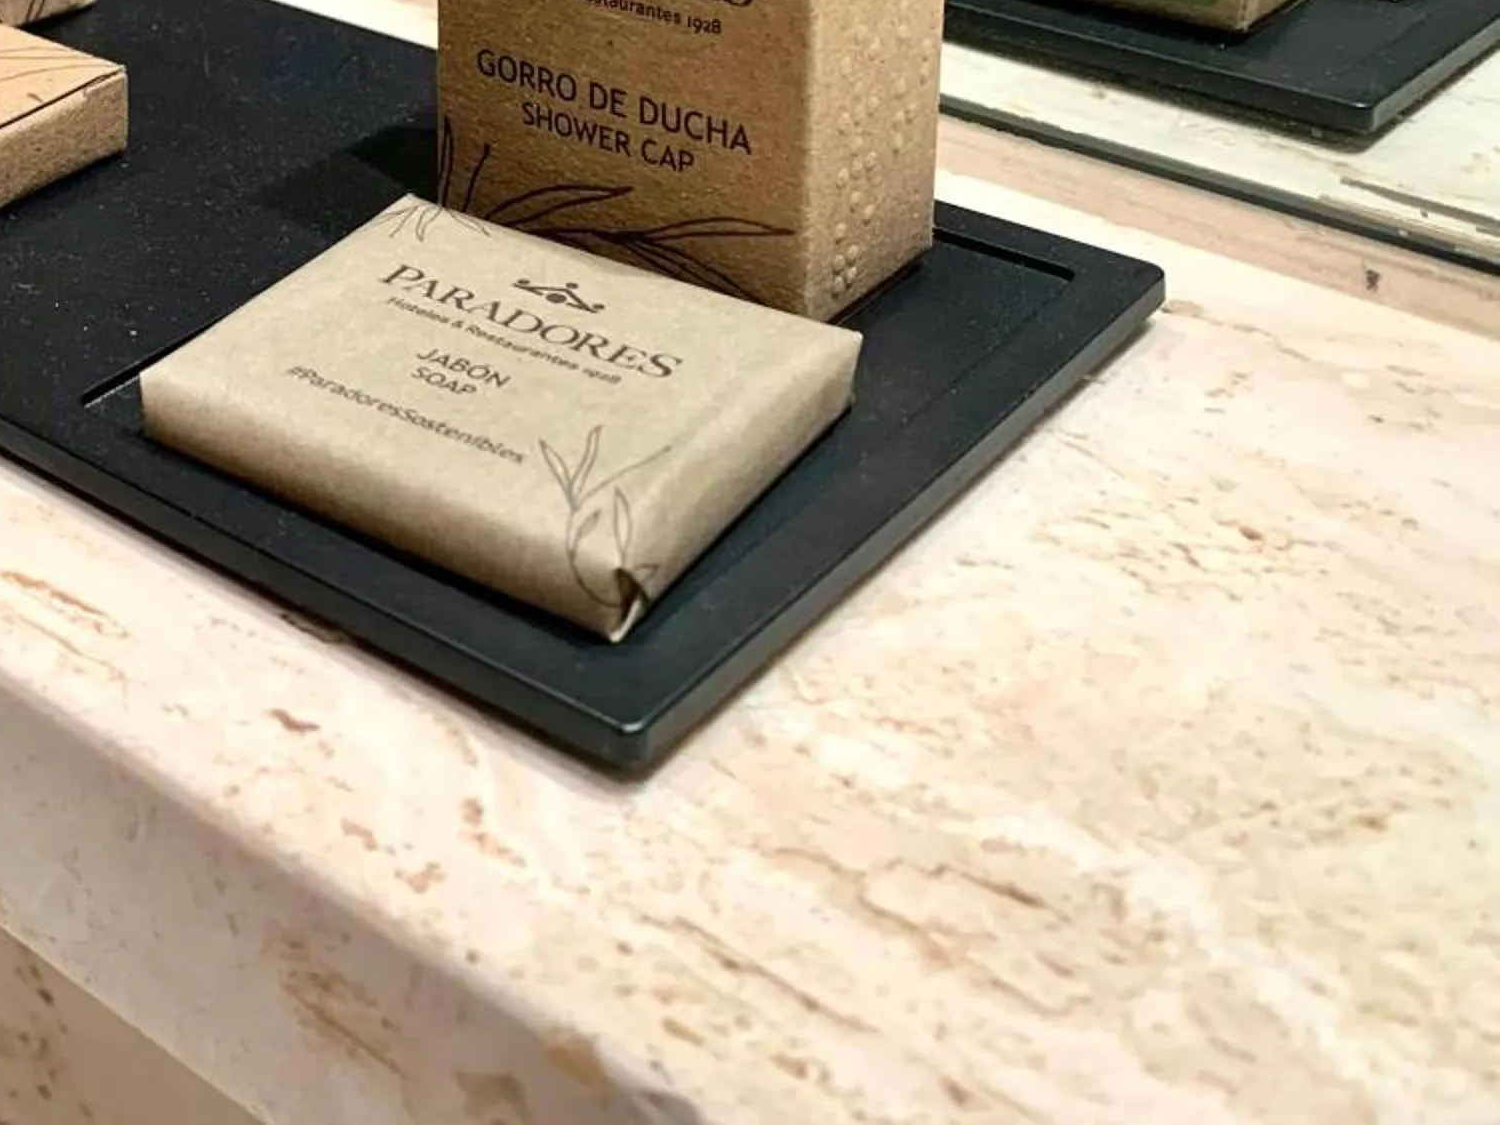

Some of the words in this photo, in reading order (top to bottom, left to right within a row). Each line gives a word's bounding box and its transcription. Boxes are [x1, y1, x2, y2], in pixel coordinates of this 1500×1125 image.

[687, 16, 722, 35] 1928
[476, 48, 577, 102] GORRO
[589, 81, 628, 118] DE
[639, 96, 753, 156] DUCHA
[522, 102, 631, 158] SHOWER
[640, 139, 695, 172] CAP
[380, 264, 683, 378] PARADORES
[387, 296, 451, 325] Hoteles
[453, 318, 464, 330] &
[465, 323, 580, 371] Restaurantes
[411, 366, 478, 396] SOAP
[416, 347, 512, 389] JABÓN
[287, 365, 526, 465] #ParadoresSostenibles
